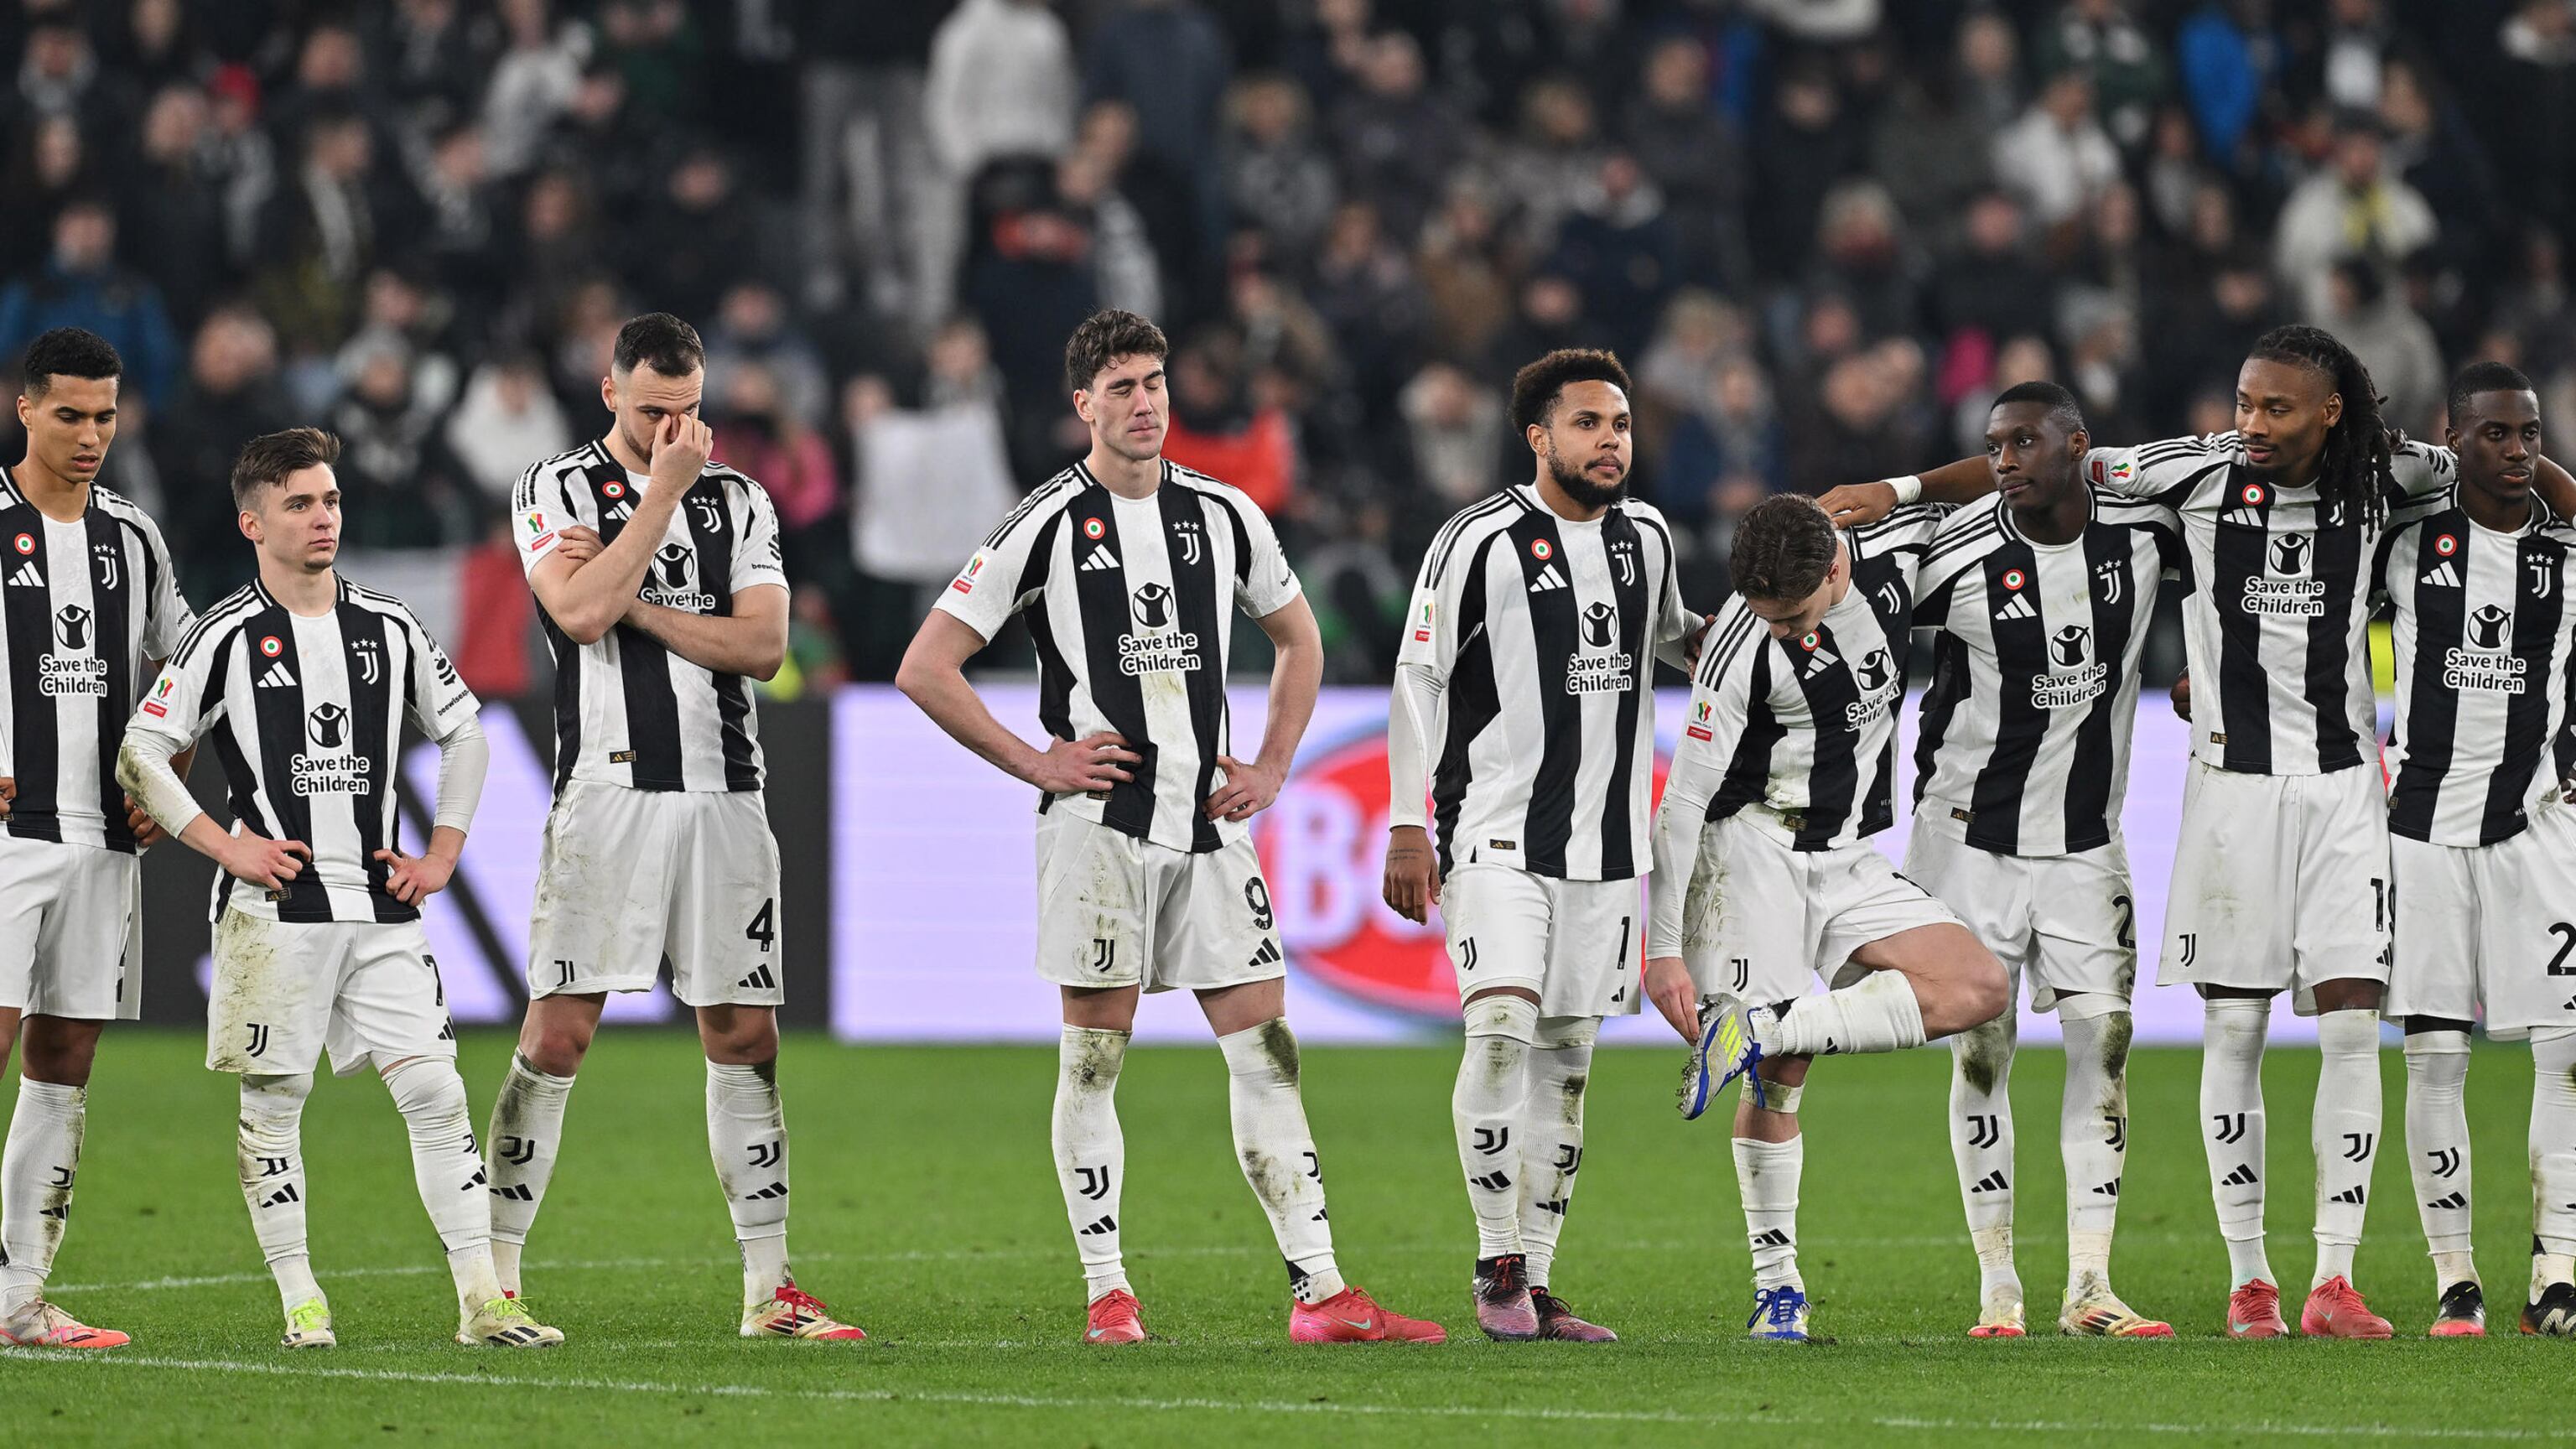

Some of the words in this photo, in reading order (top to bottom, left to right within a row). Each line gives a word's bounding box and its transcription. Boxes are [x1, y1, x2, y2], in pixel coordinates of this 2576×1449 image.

[2246, 577, 2291, 594] Save
[2295, 579, 2324, 595] the
[641, 589, 685, 607] Save
[686, 592, 714, 608] the
[2244, 598, 2323, 615] Children
[1120, 635, 1162, 653] Save
[1166, 633, 1196, 649] the
[42, 656, 81, 673] Save
[85, 657, 106, 673] the
[1123, 653, 1199, 673] Children
[1569, 653, 1607, 672] Save
[1610, 653, 1631, 669] the
[2447, 649, 2491, 669] Save
[2495, 654, 2525, 672] the
[42, 677, 106, 695] Children
[1568, 674, 1630, 693] Children
[2033, 674, 2078, 690] Save
[2081, 664, 2106, 682] the
[2446, 672, 2525, 693] Children
[2033, 681, 2105, 706] Children
[1847, 694, 1883, 719] Save
[293, 756, 336, 772] Save
[340, 754, 367, 771] the
[293, 776, 367, 794] Children
[1244, 877, 1273, 930] 9
[746, 897, 775, 953] 4
[2112, 896, 2137, 949] 2
[2547, 922, 2576, 976] 2
